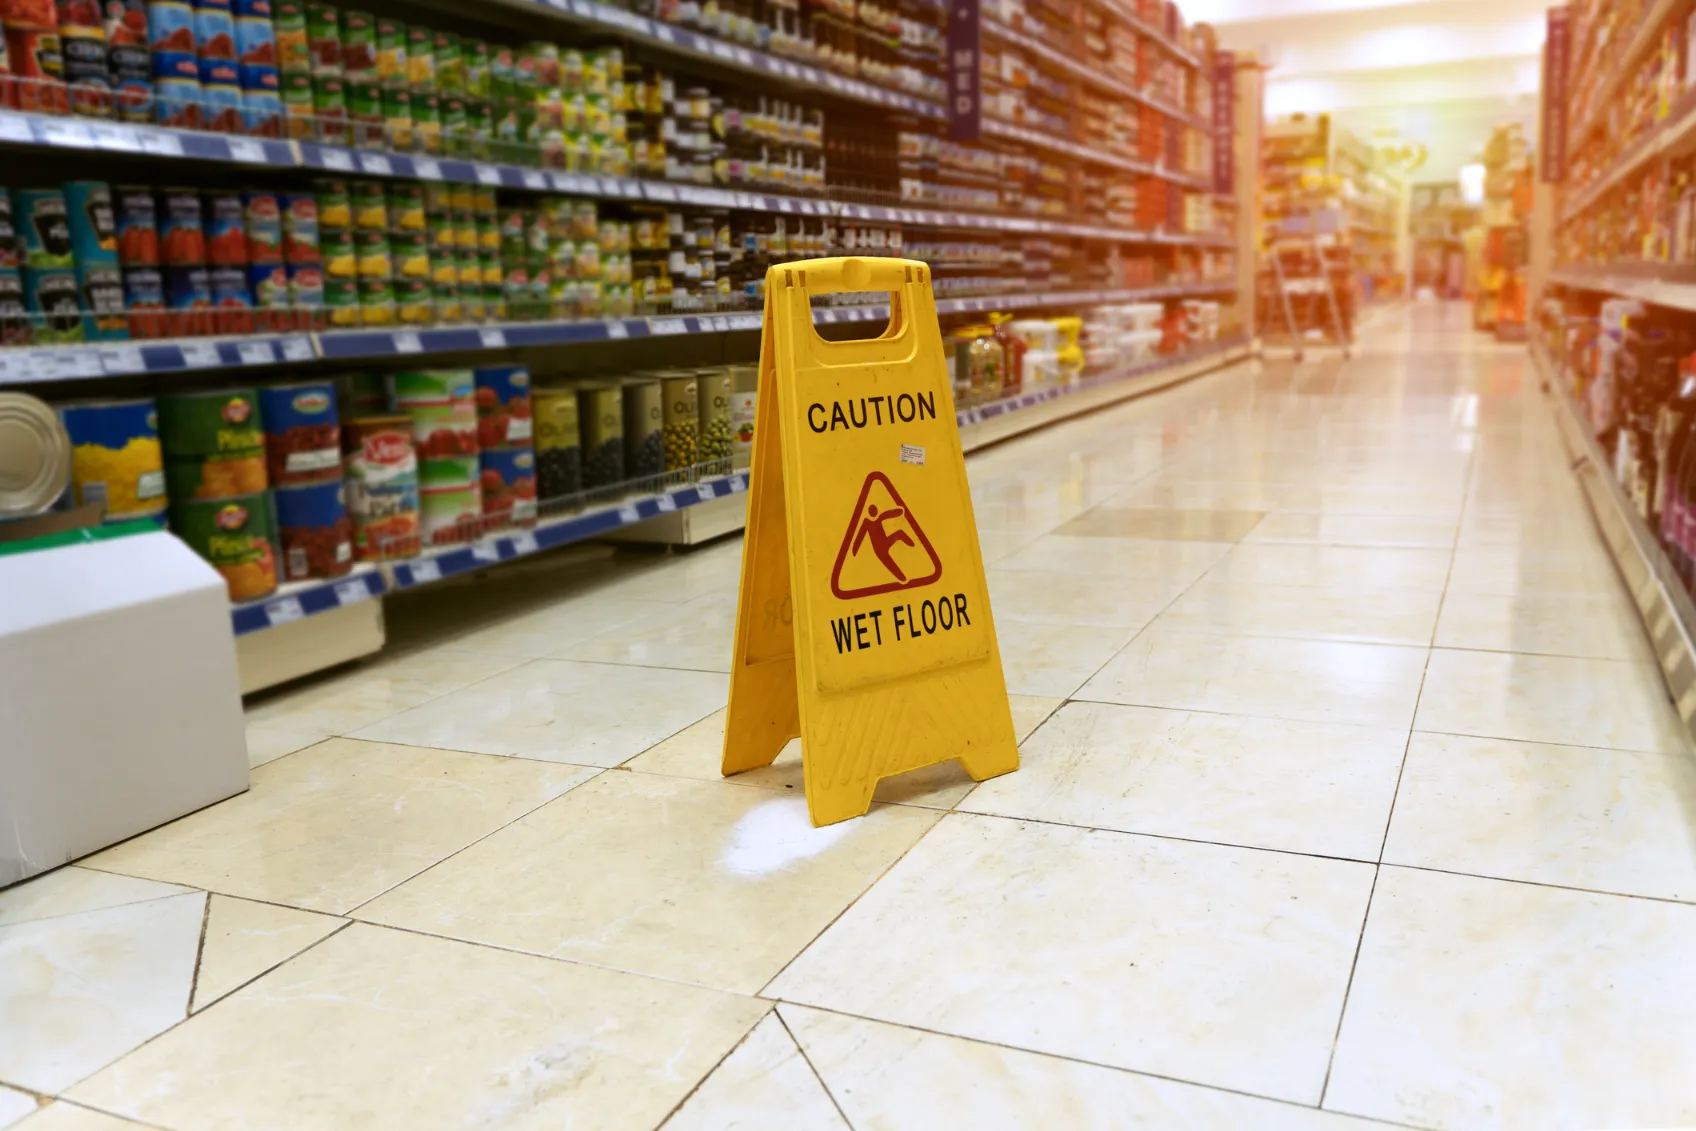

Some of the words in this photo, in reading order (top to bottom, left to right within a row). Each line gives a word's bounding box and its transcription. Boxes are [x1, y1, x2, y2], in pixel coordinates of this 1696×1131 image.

[807, 391, 936, 433] CAUTION
[831, 610, 882, 654] WET
[893, 593, 971, 641] FLOOR
